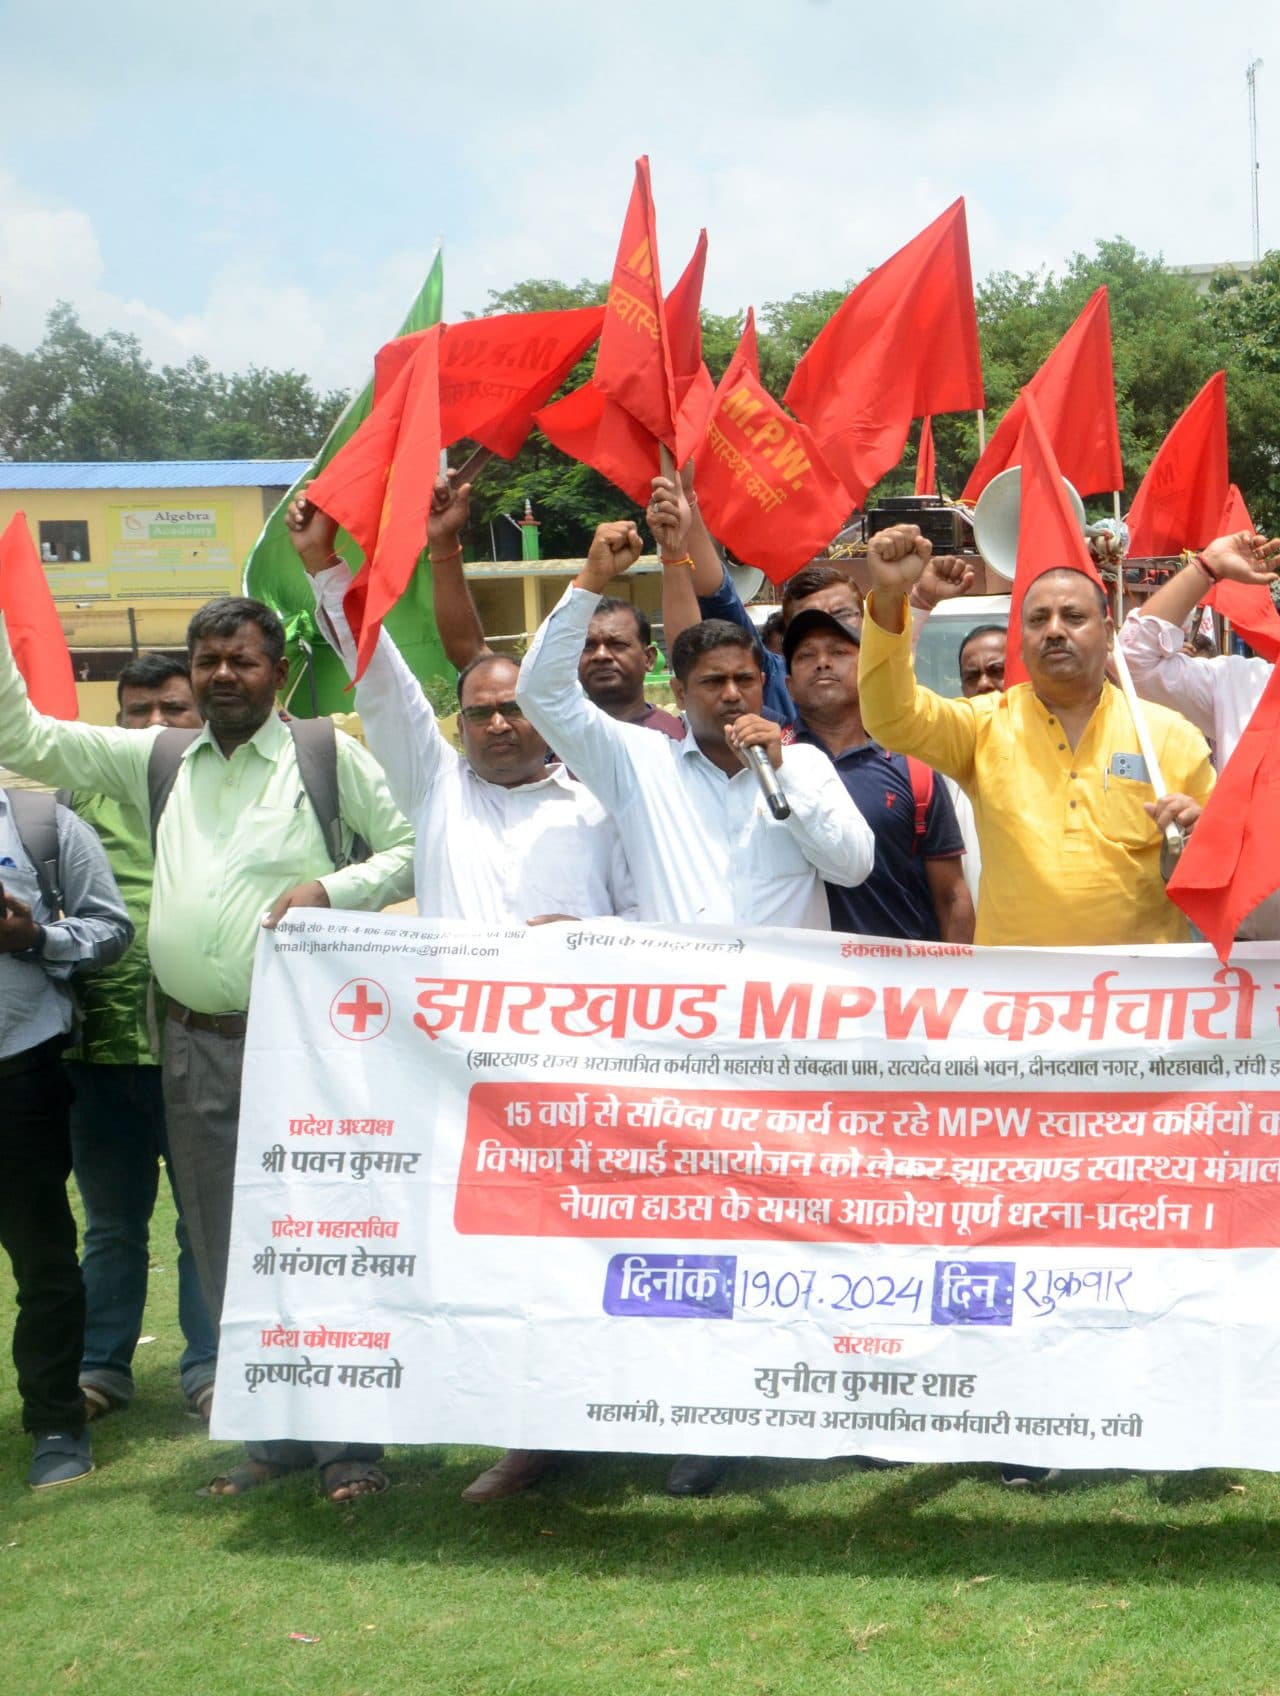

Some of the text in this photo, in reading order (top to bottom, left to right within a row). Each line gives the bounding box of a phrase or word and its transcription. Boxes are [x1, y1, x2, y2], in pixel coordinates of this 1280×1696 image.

[721, 387, 811, 491] M.P.W.
[154, 511, 210, 523] Algebra
[566, 931, 616, 950] दुनिया
[726, 938, 745, 954] हो
[840, 940, 903, 958] इंकलाब
[413, 977, 727, 1040] झारखण्ड
[739, 981, 969, 1041] MPW
[983, 966, 1261, 1041] कर्मचारी
[467, 1049, 538, 1072] (झारखण्ड
[543, 1054, 578, 1070] राज्य
[583, 1053, 660, 1074] अराजपत्रित
[664, 1053, 719, 1075] कर्मचारी
[723, 1055, 774, 1075] महासंघ
[777, 1054, 790, 1075] से
[888, 1055, 941, 1076] सत्यदेव
[945, 1055, 979, 1076] शाही
[984, 1058, 1025, 1080] भवन,
[1029, 1054, 1098, 1077] दीनदयाल
[1102, 1058, 1145, 1079] नगर,
[1149, 1055, 1230, 1079] मोरहाबादी,
[1235, 1054, 1266, 1076] रांची
[288, 1113, 395, 1137] प्रदेश अध्यक्ष
[504, 1101, 531, 1126] 15
[593, 1094, 622, 1127] से
[720, 1106, 762, 1133] पर
[766, 1101, 832, 1135] कार्य
[838, 1110, 887, 1136] कर
[892, 1102, 932, 1136] रहे
[938, 1107, 1031, 1138] MPW
[1037, 1111, 1149, 1138] स्वास्थ्य
[1152, 1102, 1254, 1136] कर्मियों
[261, 1143, 422, 1180] श्री पवन कुमार
[476, 1140, 565, 1173] विभाग
[570, 1140, 593, 1173] में
[597, 1140, 667, 1177] स्थाई
[671, 1142, 815, 1177] समायोजन
[820, 1147, 863, 1178] को
[866, 1148, 946, 1180] लेकर
[950, 1156, 1084, 1184] झारखण्ड
[1087, 1155, 1198, 1182] स्वास्थ्य
[271, 1214, 400, 1239] प्रदेश महासचिव
[560, 1186, 637, 1220] नेपाल
[641, 1193, 713, 1221] हाउस
[720, 1187, 753, 1222] के
[757, 1197, 833, 1225] समक्ष
[838, 1191, 947, 1228] आक्रोश
[952, 1193, 1005, 1236] पूर्ण
[1008, 1195, 1193, 1231] धरना-प्रदर्शन
[252, 1245, 416, 1278] श्री मंगल हेम्ब्रम
[741, 1269, 924, 1313] 19.07.2024
[261, 1324, 391, 1350] प्रदेश कोषाध्यक्ष
[832, 1332, 904, 1355] संरक्षक
[244, 1356, 405, 1394] कृष्णदेव महतो
[754, 1361, 977, 1401] सुनील कुमार शाह
[586, 1399, 1144, 1440] महामंत्री, झारखण्ड राज्य अराजपत्रित कर्मचारी महासंघ, रांची
